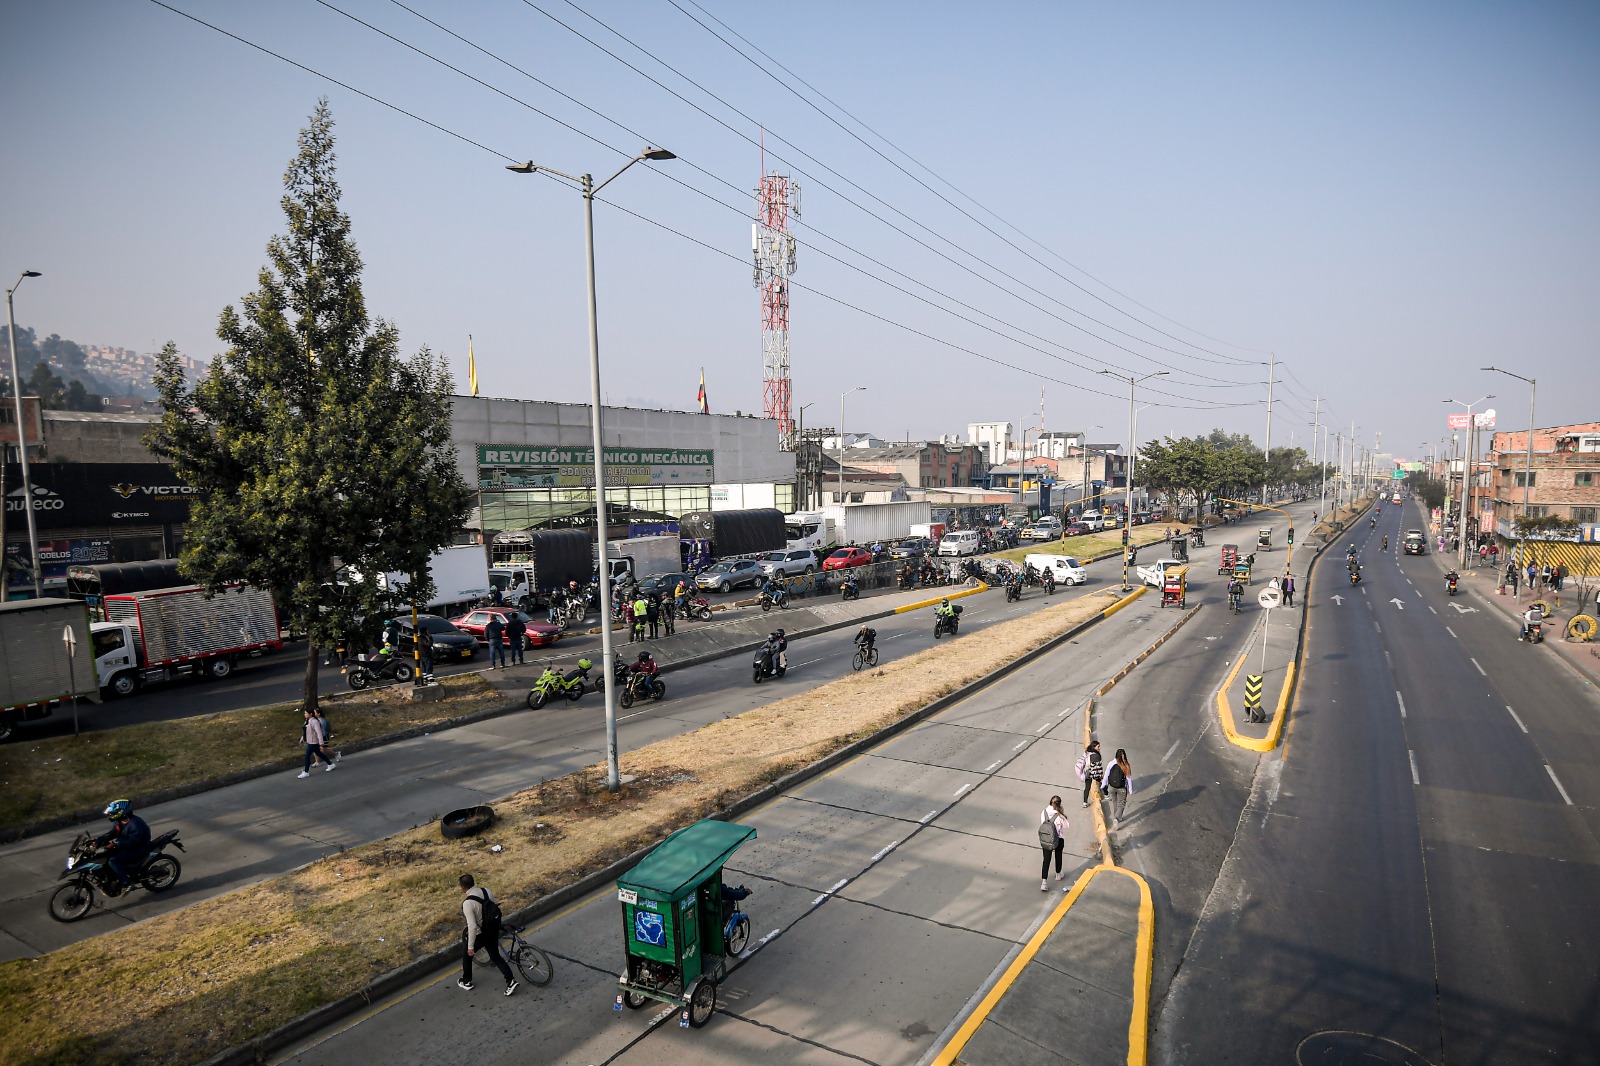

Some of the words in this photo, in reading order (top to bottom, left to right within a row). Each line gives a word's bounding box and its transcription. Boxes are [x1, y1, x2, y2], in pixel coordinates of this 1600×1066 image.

[485, 448, 571, 463] REVISIÓN
[575, 449, 638, 463] TÉNICO
[641, 451, 709, 464] MECÁNICA
[560, 467, 579, 476] CDA
[614, 466, 651, 476] ESTACIÓN
[6, 499, 65, 512] aueco
[72, 546, 108, 560] 2025
